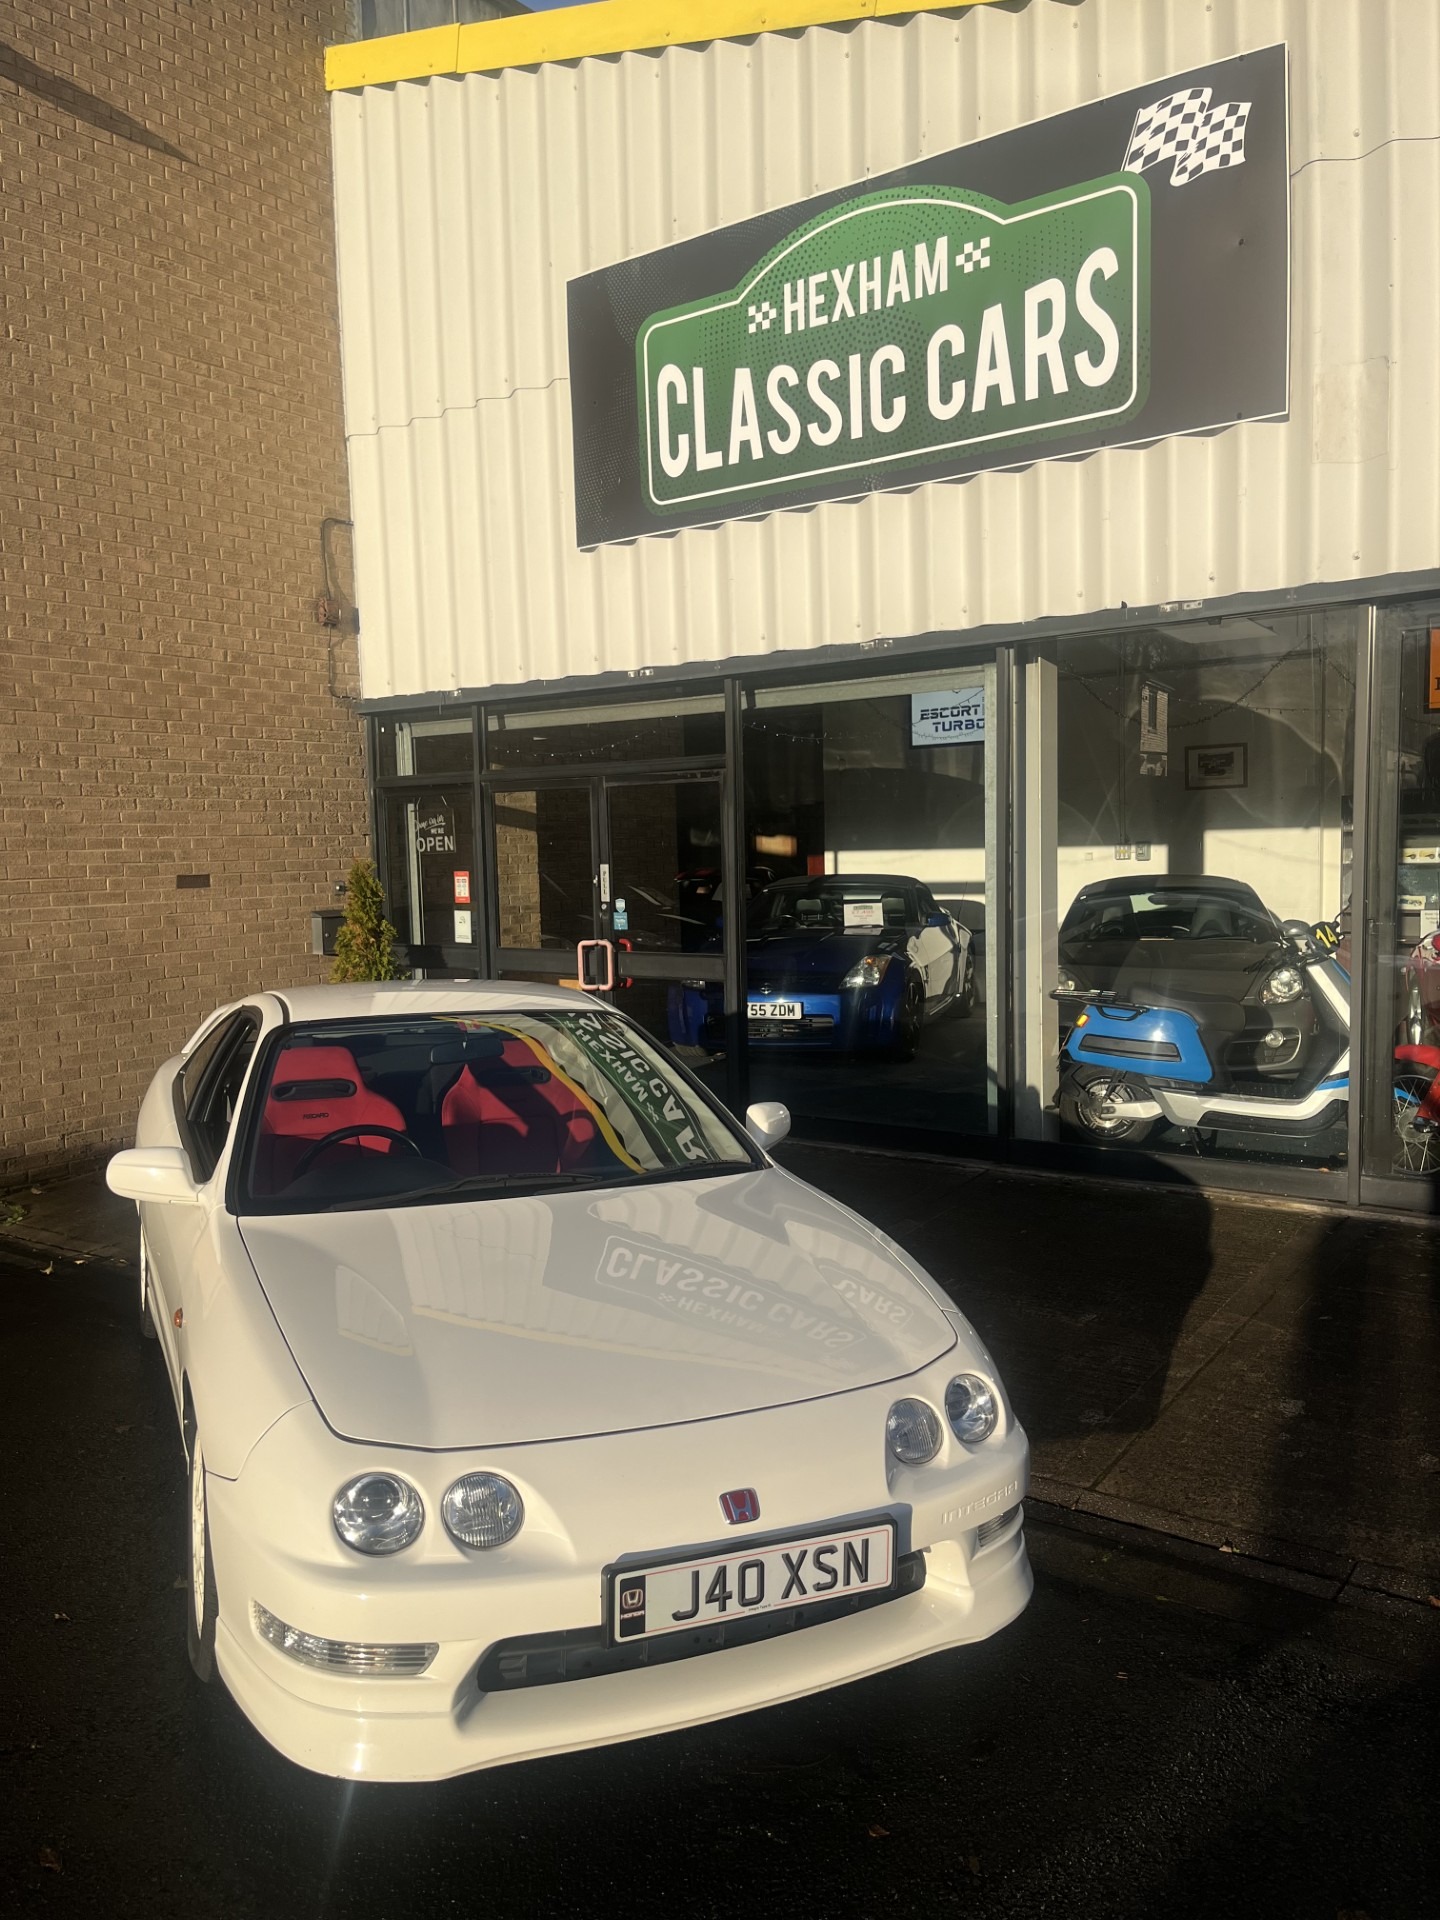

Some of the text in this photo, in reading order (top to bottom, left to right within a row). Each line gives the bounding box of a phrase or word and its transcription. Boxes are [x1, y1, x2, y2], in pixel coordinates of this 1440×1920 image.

[782, 235, 950, 334] HEXHAM
[657, 246, 1121, 478] CLASSIC CARS
[920, 704, 981, 720] ESCORT
[932, 718, 985, 733] TURBO
[416, 835, 455, 852] OPEN
[1316, 924, 1338, 948] 14
[747, 1004, 795, 1016] 55 ZDM
[941, 1480, 1018, 1525] INTEGRA
[671, 1537, 870, 1622] J40 XSN
[621, 1610, 645, 1620] HONDA
